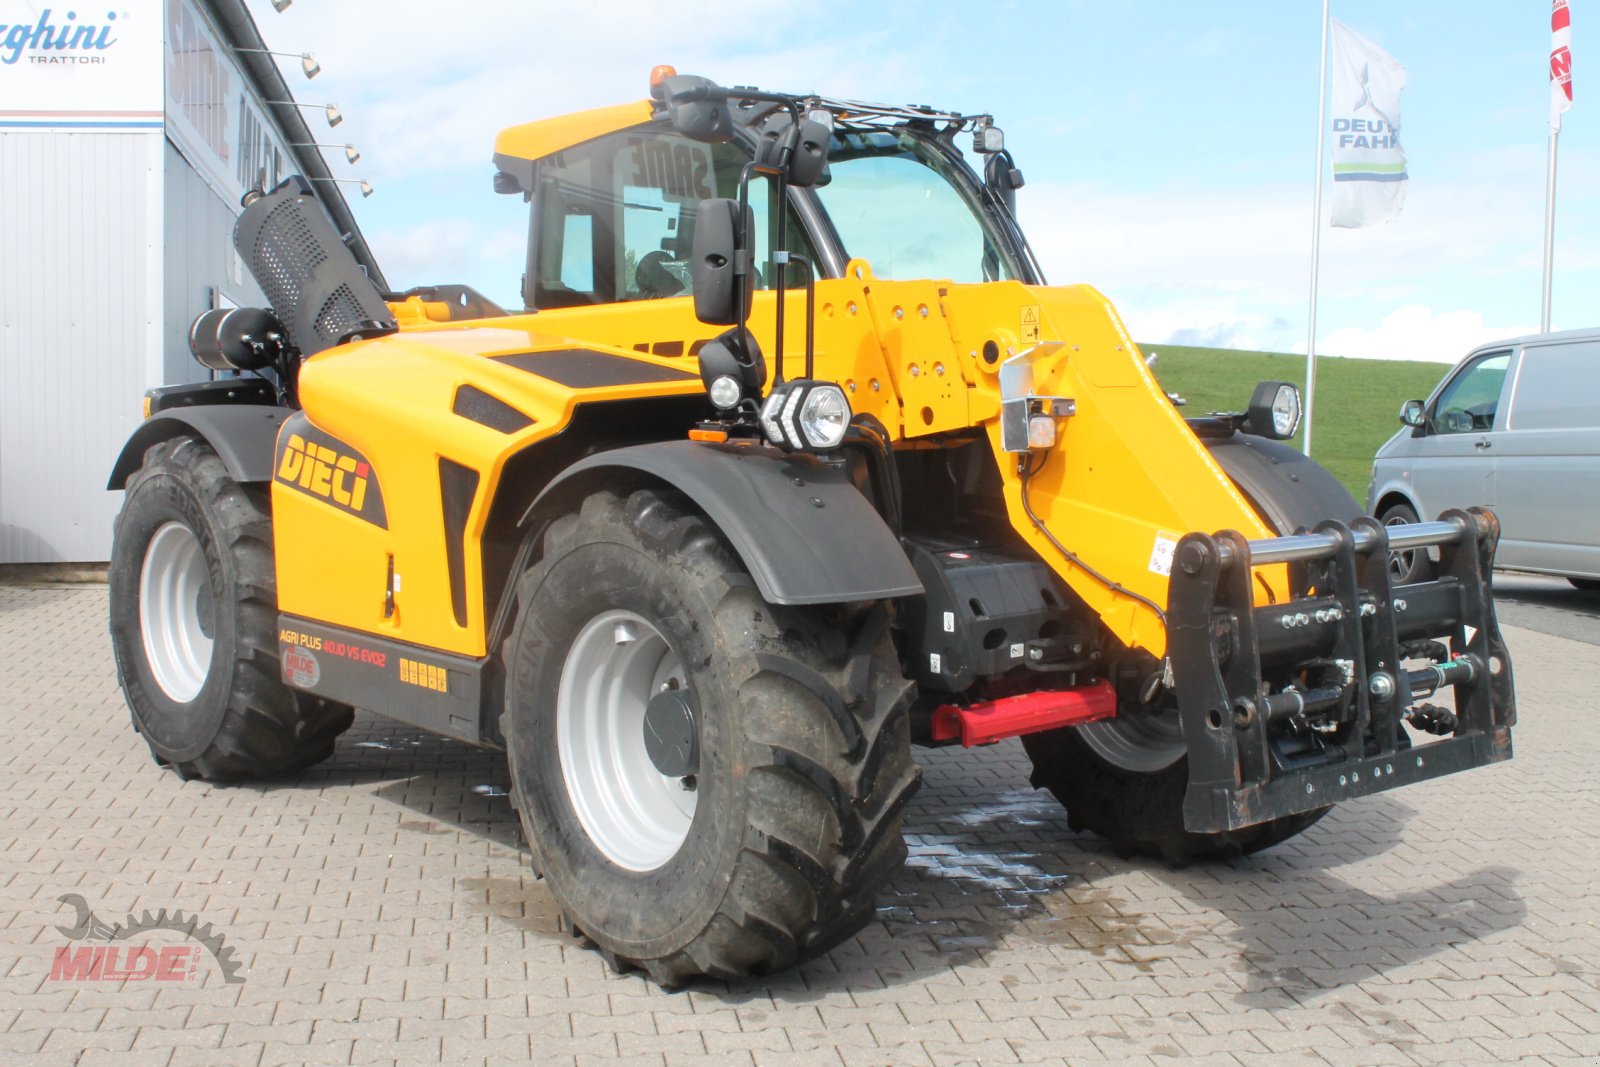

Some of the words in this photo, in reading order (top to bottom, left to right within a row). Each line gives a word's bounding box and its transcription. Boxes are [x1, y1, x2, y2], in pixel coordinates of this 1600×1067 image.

[28, 56, 105, 64] TRATTORI
[280, 629, 299, 645] AGRI
[300, 633, 322, 650] PLUS
